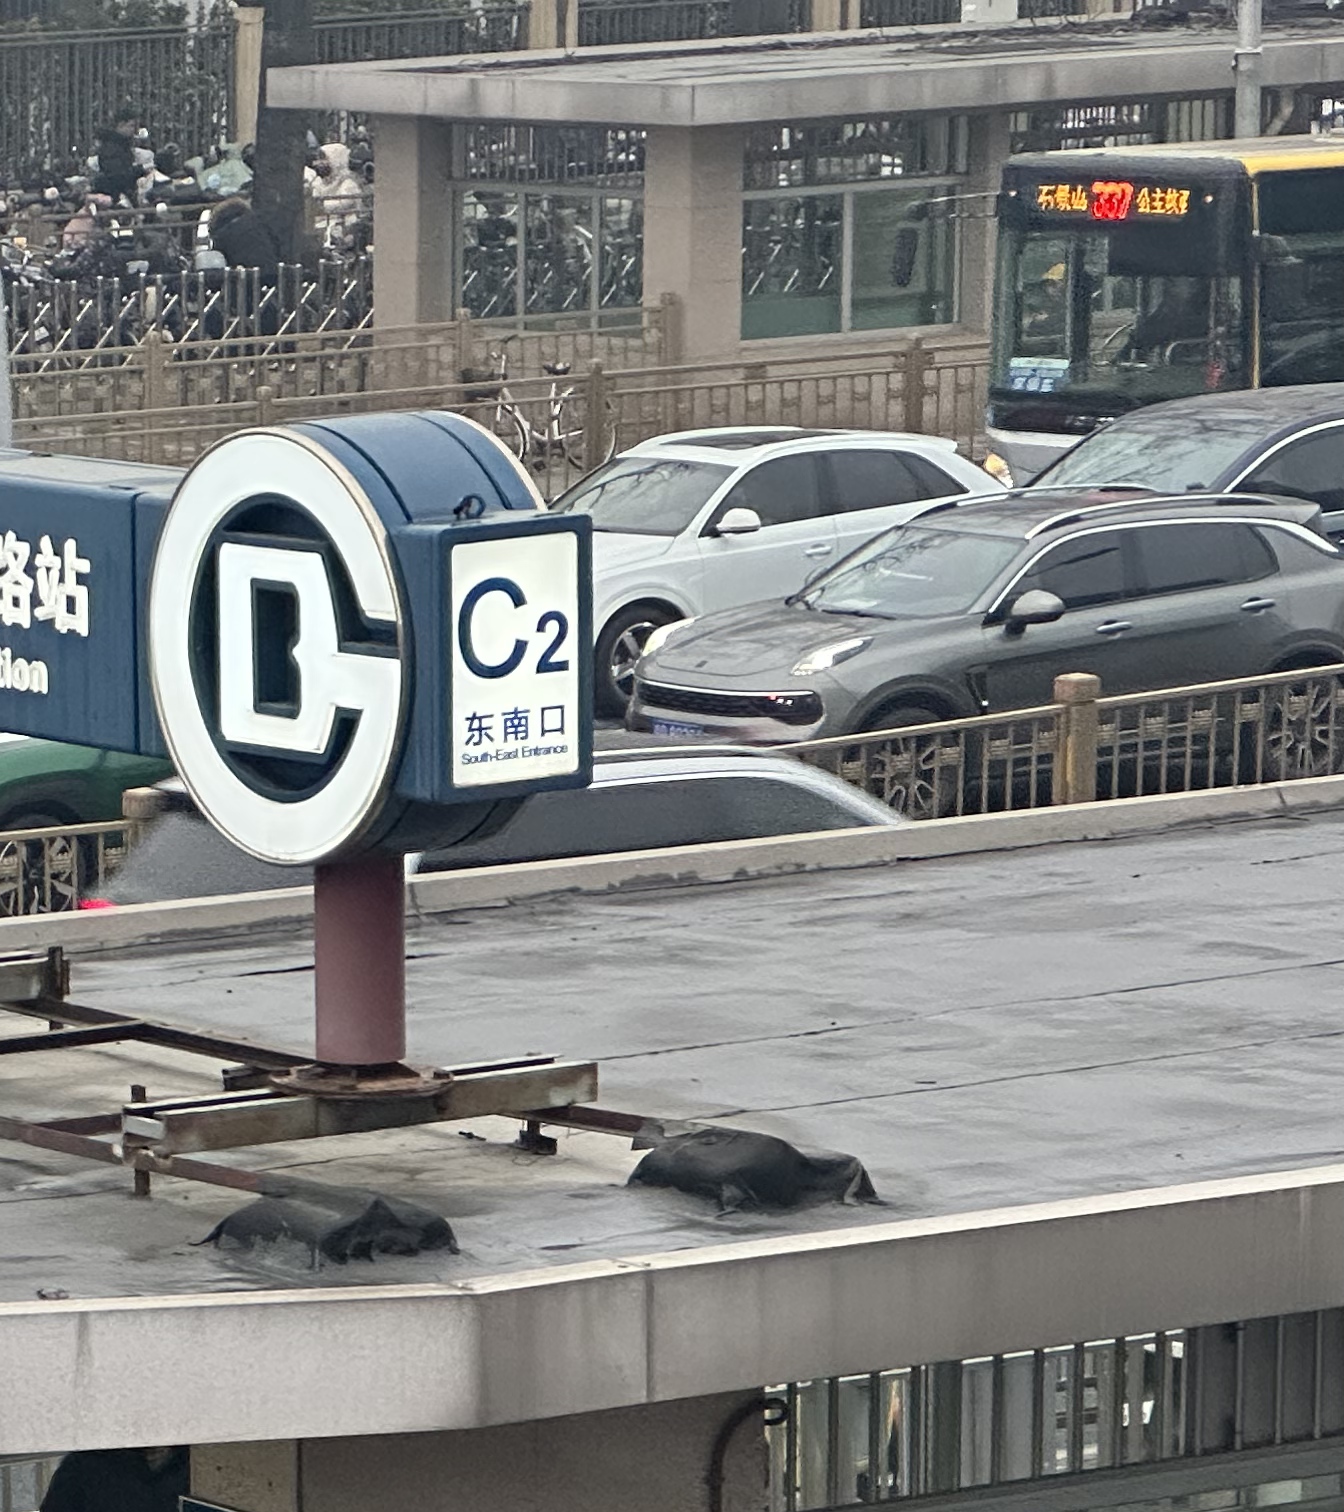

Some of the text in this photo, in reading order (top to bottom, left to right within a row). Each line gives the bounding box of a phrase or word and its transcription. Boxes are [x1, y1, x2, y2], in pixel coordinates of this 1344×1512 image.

[1038, 184, 1088, 211] 石景山
[458, 576, 570, 680] C2
[464, 705, 565, 747] 东南口
[462, 744, 569, 765] South-East Entrance
